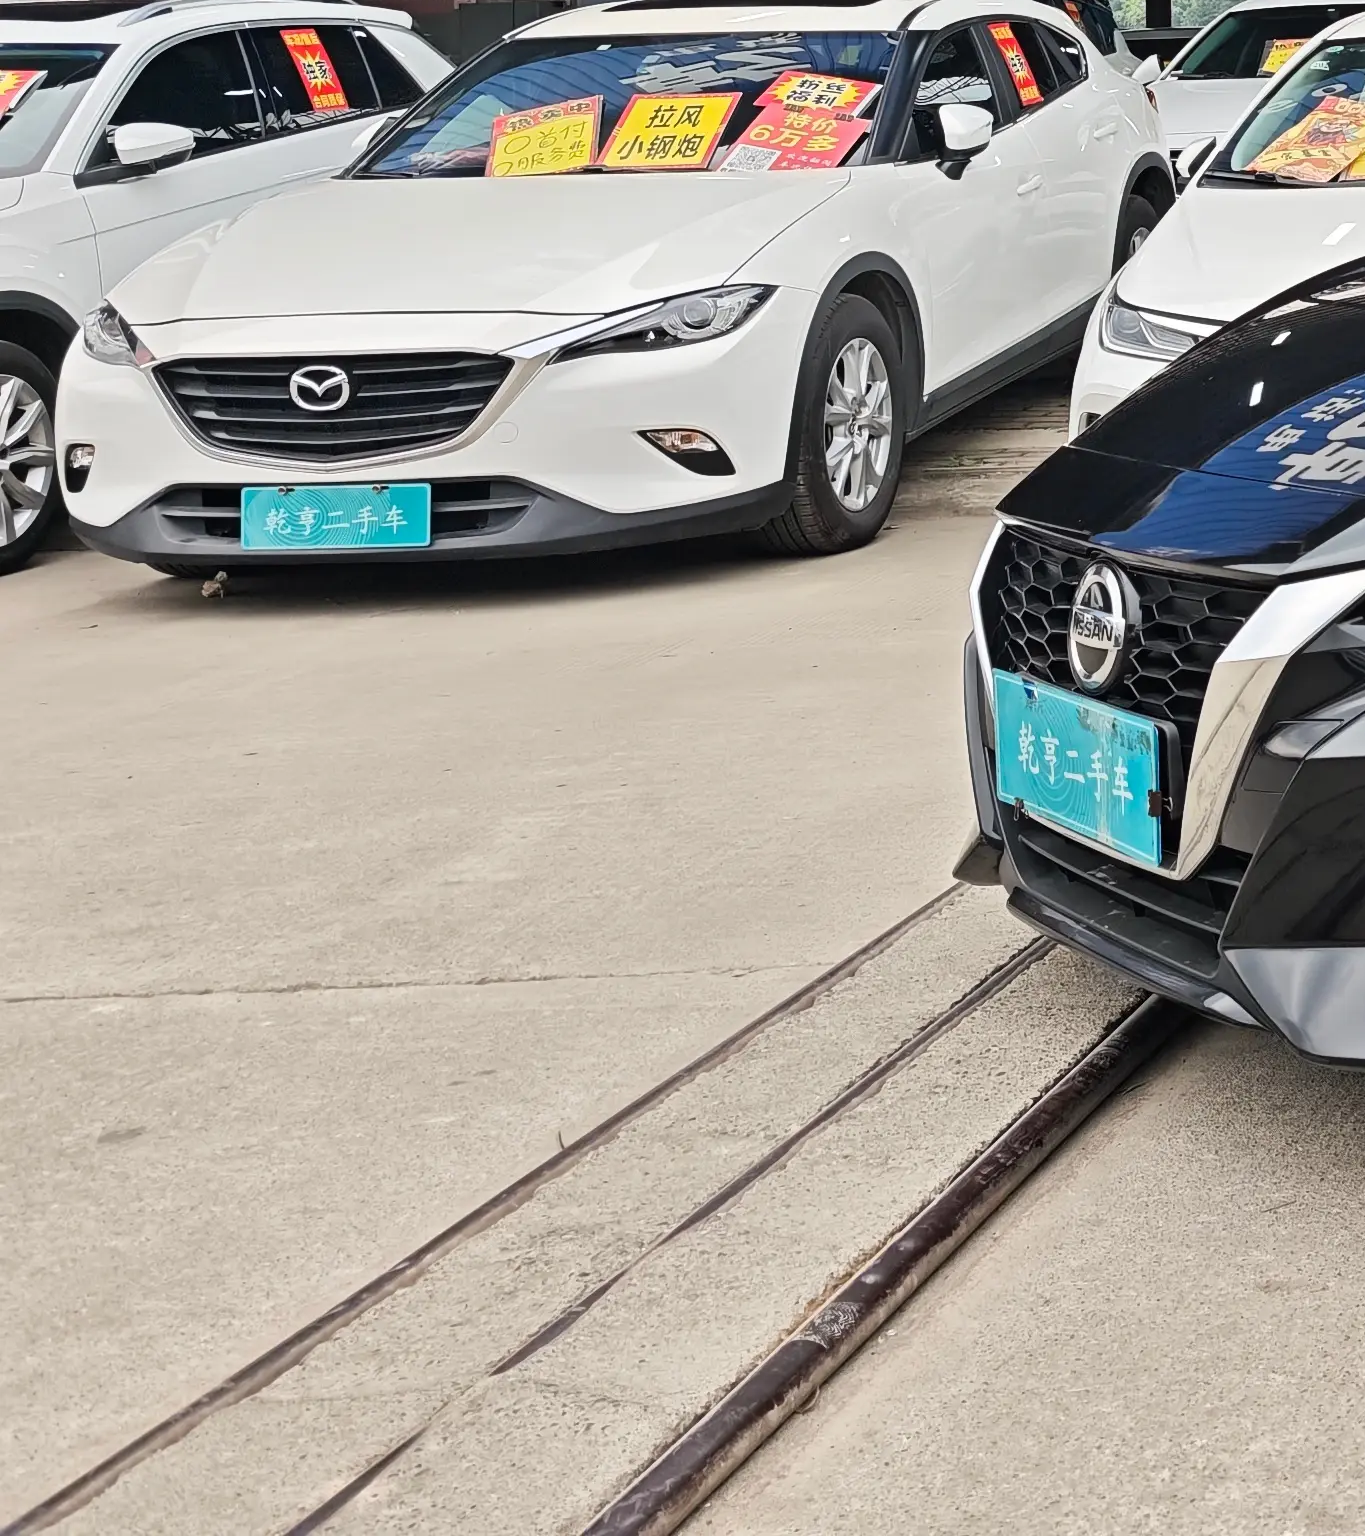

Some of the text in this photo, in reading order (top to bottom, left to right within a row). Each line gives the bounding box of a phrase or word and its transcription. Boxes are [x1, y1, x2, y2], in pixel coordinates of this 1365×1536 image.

[786, 89, 838, 107] 福利
[796, 78, 847, 95] 粉丝
[645, 104, 705, 128] 拉风
[783, 111, 838, 135] 特价
[616, 134, 705, 161] 小钢炮
[749, 124, 840, 152] 6万多
[263, 505, 409, 537] 乾亨二手车
[1018, 720, 1134, 817] 乾亨二手车
